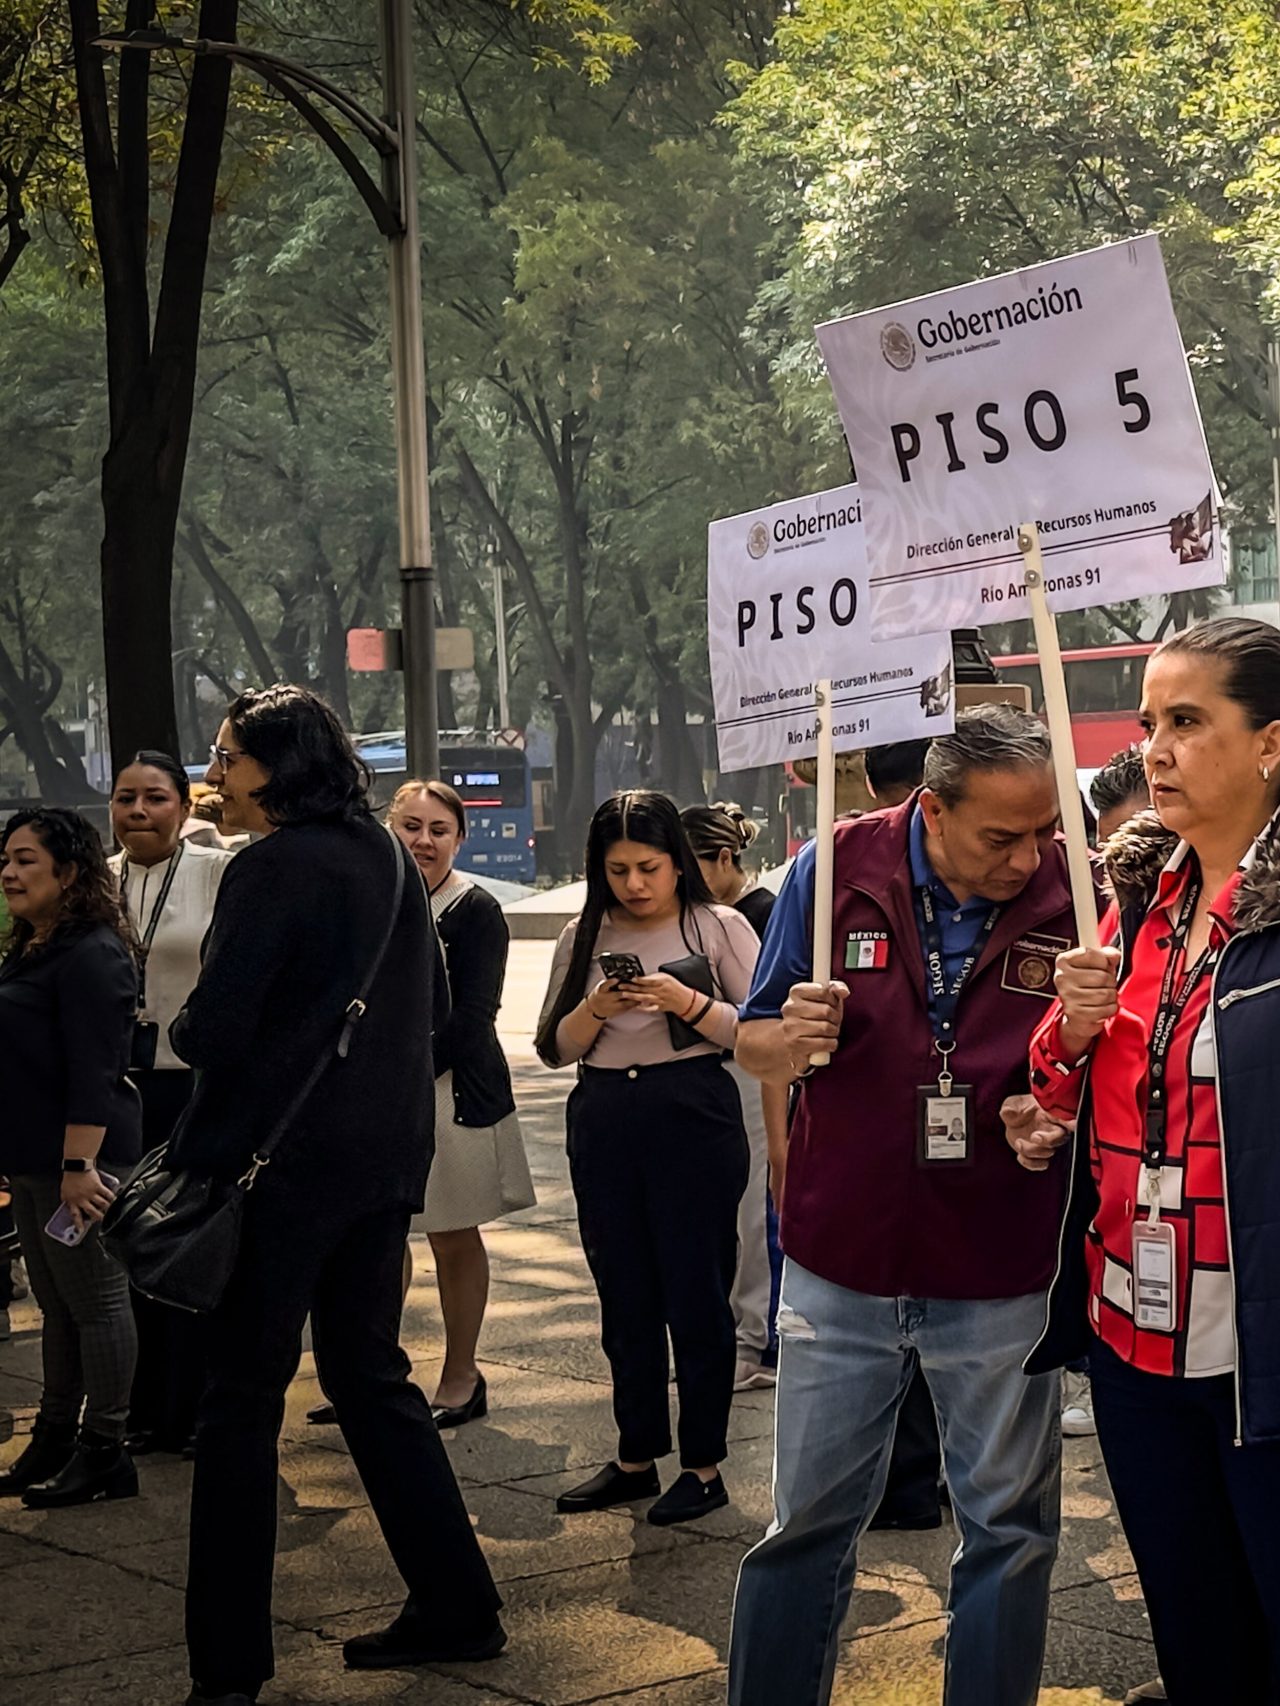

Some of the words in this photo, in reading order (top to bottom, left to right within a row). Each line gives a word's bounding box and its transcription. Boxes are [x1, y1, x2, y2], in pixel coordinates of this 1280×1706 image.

[918, 282, 1083, 349] Gobernación
[890, 389, 1068, 483] PISO
[1114, 368, 1152, 434] 5
[773, 499, 862, 543] Gobernaci
[906, 537, 964, 560] Dirección
[966, 525, 1015, 549] General
[1035, 513, 1092, 535] Recursos
[1094, 499, 1157, 523] Humanos
[981, 585, 1004, 604] Río
[1007, 573, 1083, 600] Amzonas
[1085, 567, 1101, 587] 91
[737, 577, 858, 648] PISO
[740, 690, 777, 709] Dirección
[778, 683, 812, 700] General
[869, 667, 914, 684] Humanos
[858, 718, 870, 733] 91
[848, 931, 888, 940] MÉXICO
[928, 951, 945, 996] SEGOB
[950, 956, 976, 996] SEGOB
